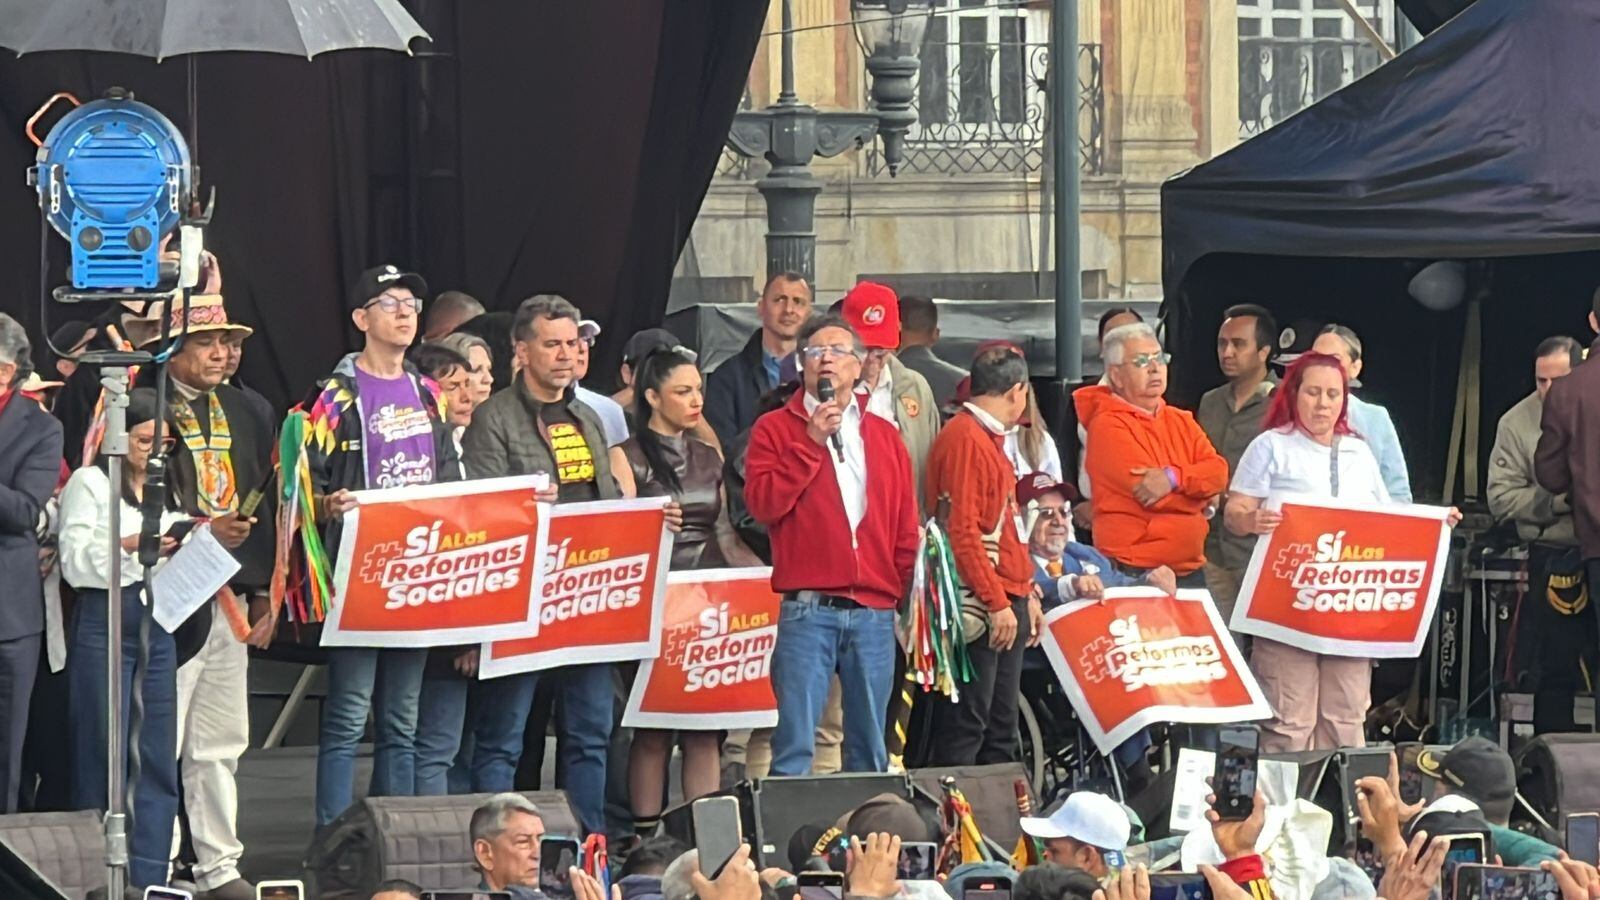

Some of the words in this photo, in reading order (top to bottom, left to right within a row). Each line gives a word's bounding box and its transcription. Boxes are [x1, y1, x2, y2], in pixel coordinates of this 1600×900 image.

[387, 544, 522, 583] Reformas
[542, 562, 643, 598] eformas
[1298, 565, 1420, 585] Reformas
[385, 567, 520, 610] Sociales
[541, 586, 641, 625] ociales
[1292, 587, 1417, 613] Sociales
[687, 634, 774, 666] Reform
[1111, 643, 1214, 675] Reformas
[683, 651, 771, 692] Social
